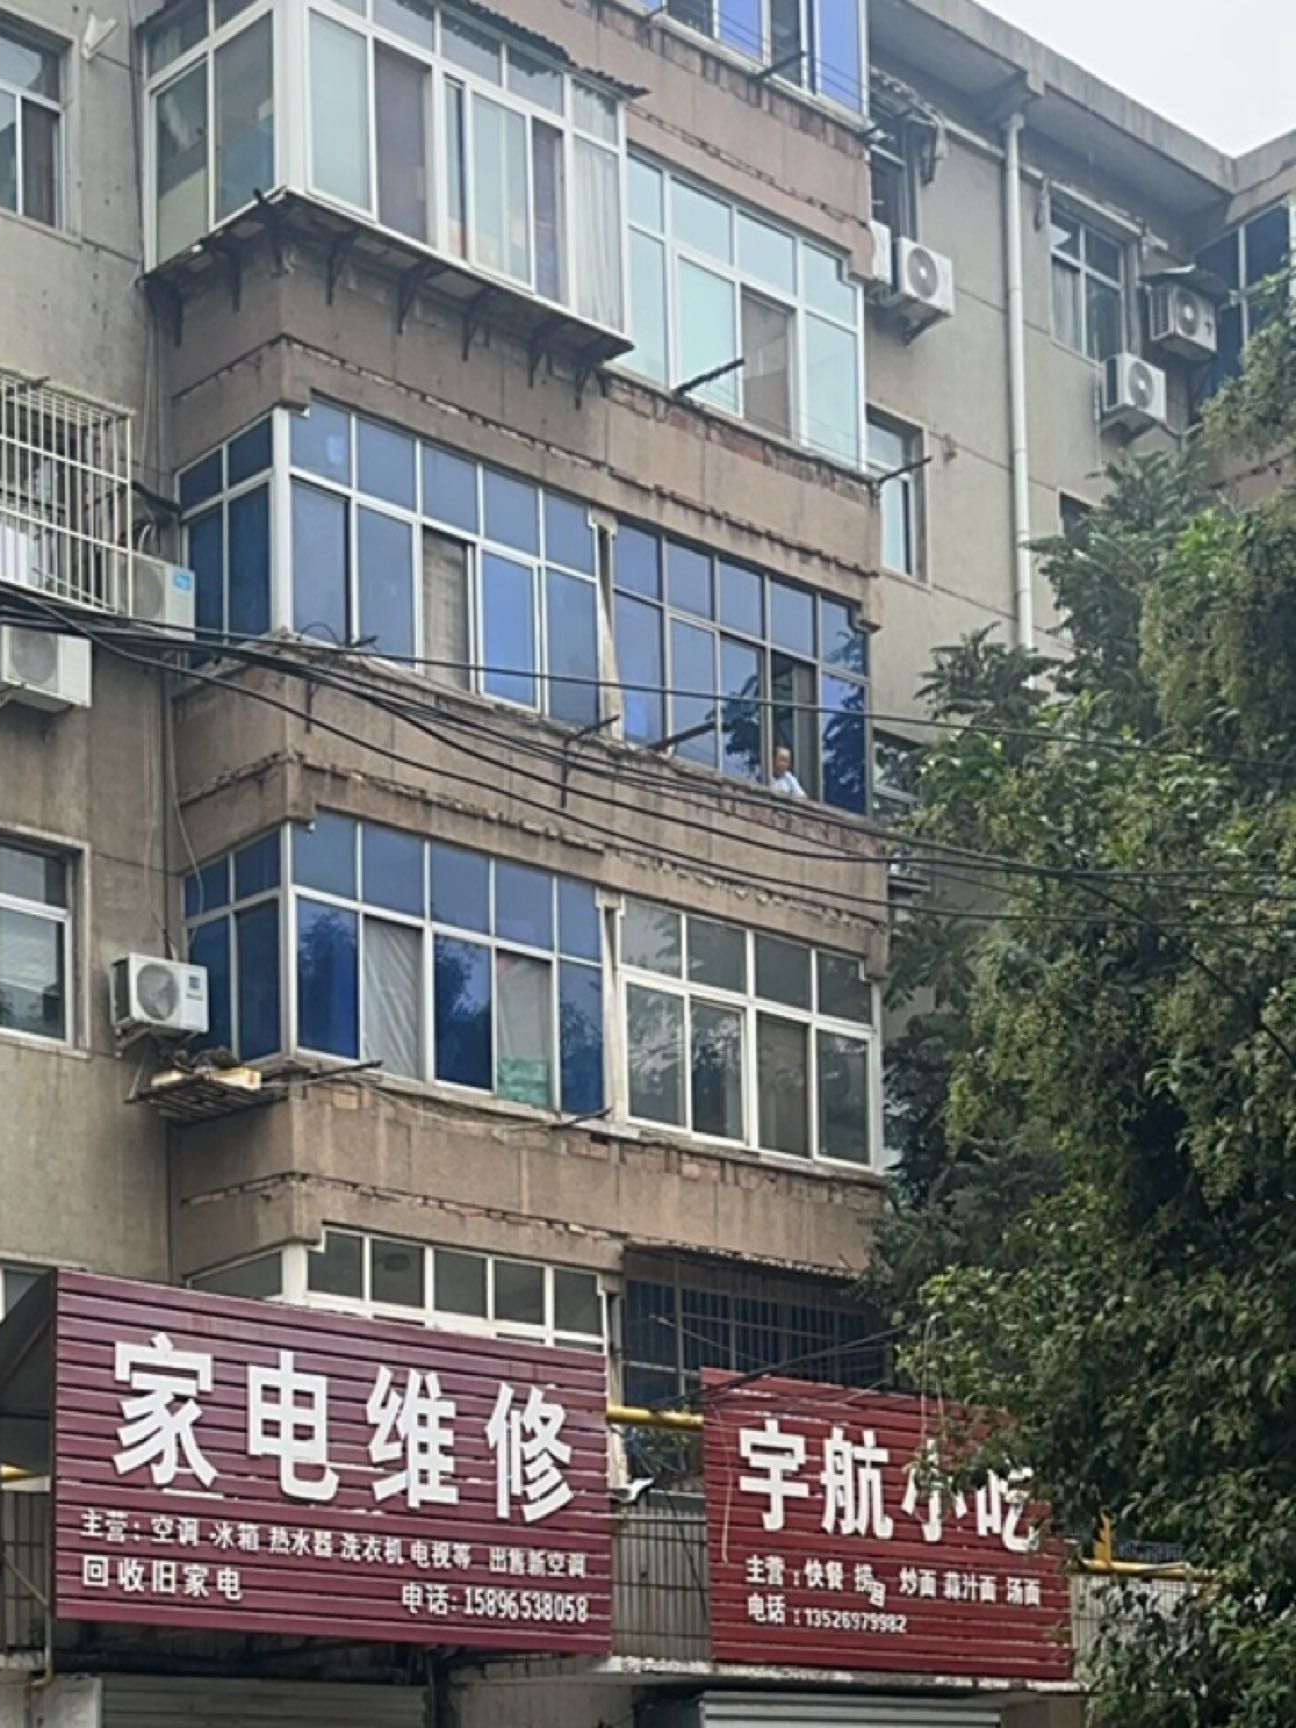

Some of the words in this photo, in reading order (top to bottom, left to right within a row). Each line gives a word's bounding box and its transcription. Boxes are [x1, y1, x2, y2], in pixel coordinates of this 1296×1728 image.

[113, 1332, 572, 1523] 家电维修
[739, 1418, 1040, 1552] 宇航小吃
[83, 1554, 243, 1600] 回收旧家电
